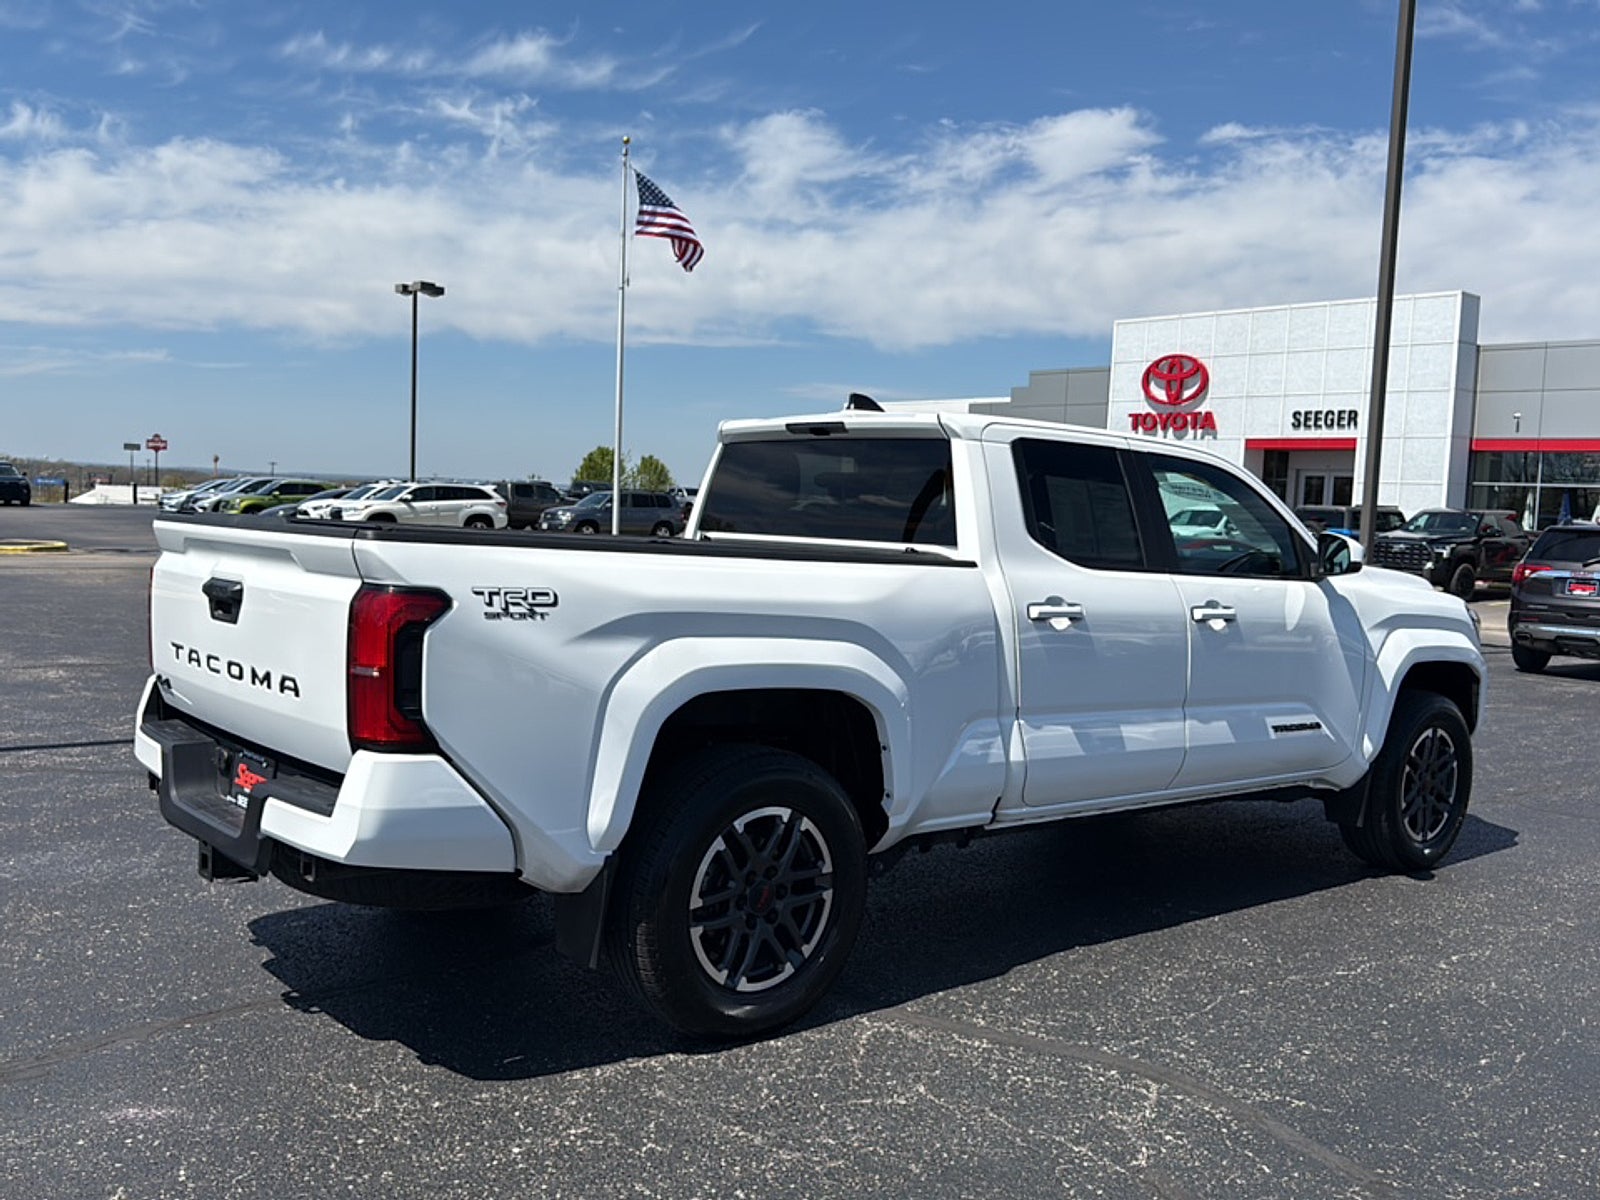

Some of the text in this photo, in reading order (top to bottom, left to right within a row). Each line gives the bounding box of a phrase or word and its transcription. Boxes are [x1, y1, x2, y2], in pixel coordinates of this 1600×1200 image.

[1128, 411, 1217, 432] TOYOTA
[1291, 409, 1359, 430] SEEGER
[471, 587, 559, 613] TRD
[483, 611, 549, 621] SPORT
[170, 641, 301, 698] TACOMA
